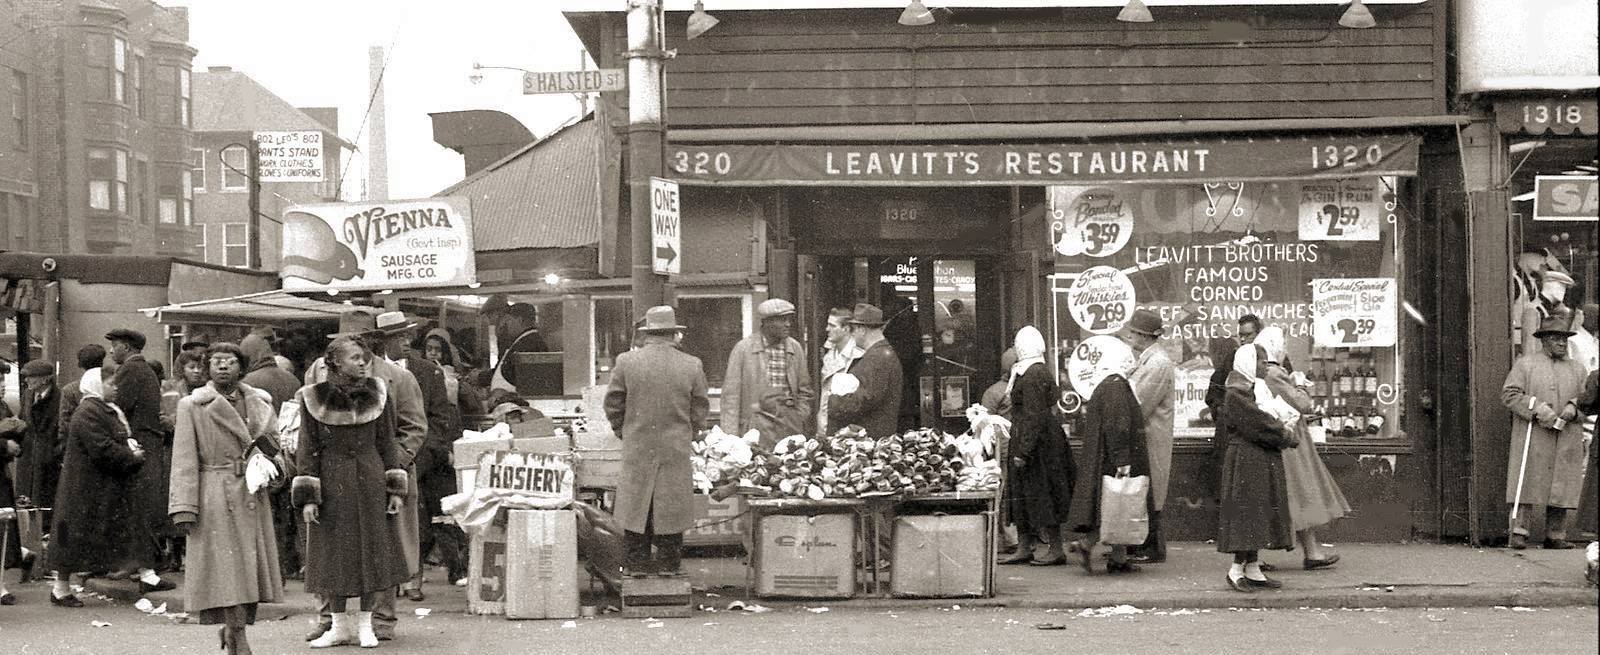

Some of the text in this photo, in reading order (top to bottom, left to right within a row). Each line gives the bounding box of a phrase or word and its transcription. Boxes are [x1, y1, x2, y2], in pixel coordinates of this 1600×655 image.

[524, 71, 619, 91] S HALSTED ST
[1522, 105, 1582, 124] 1318
[257, 134, 273, 144] 802
[303, 134, 320, 144] 802
[288, 147, 319, 157] STAND
[826, 151, 980, 175] LEAVITT'S
[1006, 149, 1209, 175] RESTAURANT
[1311, 143, 1382, 170] 1320
[280, 159, 314, 168] CLOTHES
[654, 187, 677, 213] ONE
[885, 208, 918, 221] 1320
[343, 206, 453, 261] VIENNA
[654, 213, 678, 238] WAY
[381, 253, 438, 268] SAUSAGE
[1135, 243, 1318, 264] LEAVITT BROTHERS
[387, 266, 437, 280] MFG. CO.
[897, 263, 918, 275] Blue
[1184, 266, 1268, 284] FAMOUS
[1190, 285, 1264, 302] CORNED
[489, 464, 566, 493] HOSIERY
